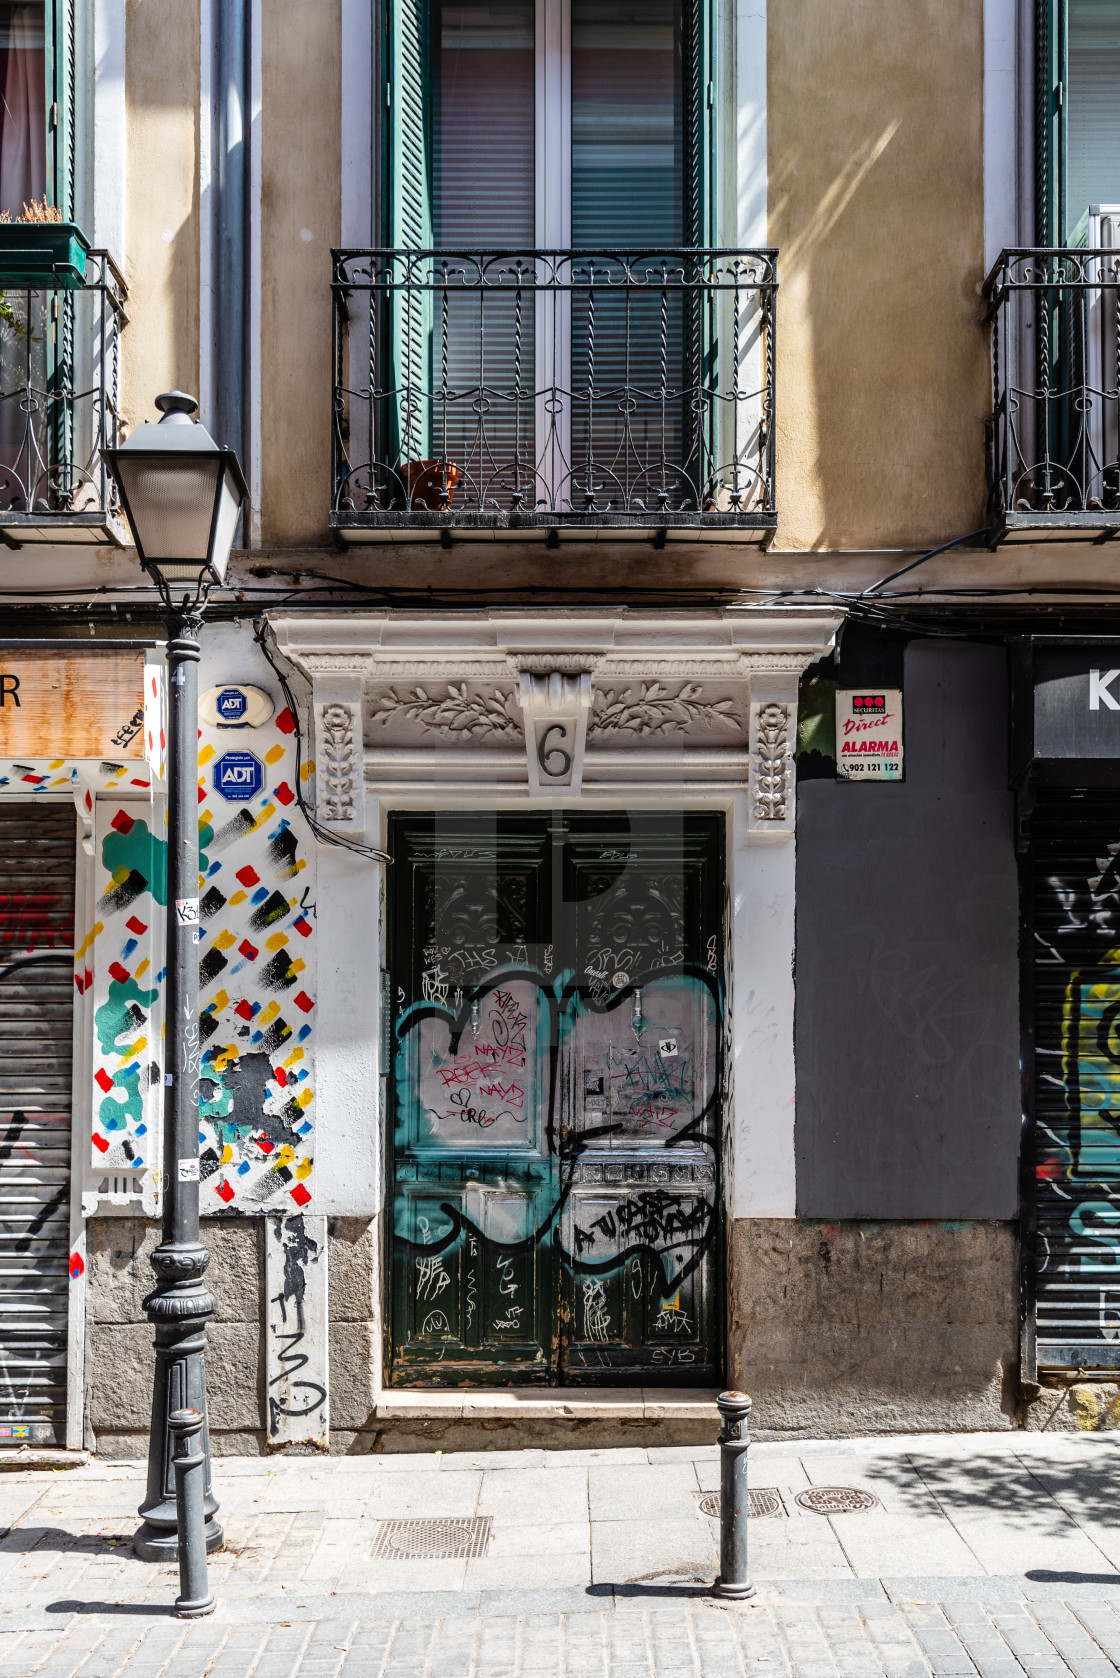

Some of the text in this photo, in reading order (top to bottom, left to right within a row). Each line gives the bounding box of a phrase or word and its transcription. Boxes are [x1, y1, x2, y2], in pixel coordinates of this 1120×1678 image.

[221, 698, 242, 709] ADT
[841, 713, 895, 736] Direct
[538, 725, 570, 777] 6
[841, 741, 899, 752] ALARMA
[867, 763, 881, 771] 121
[884, 763, 899, 771] 122
[221, 767, 254, 782] ADT
